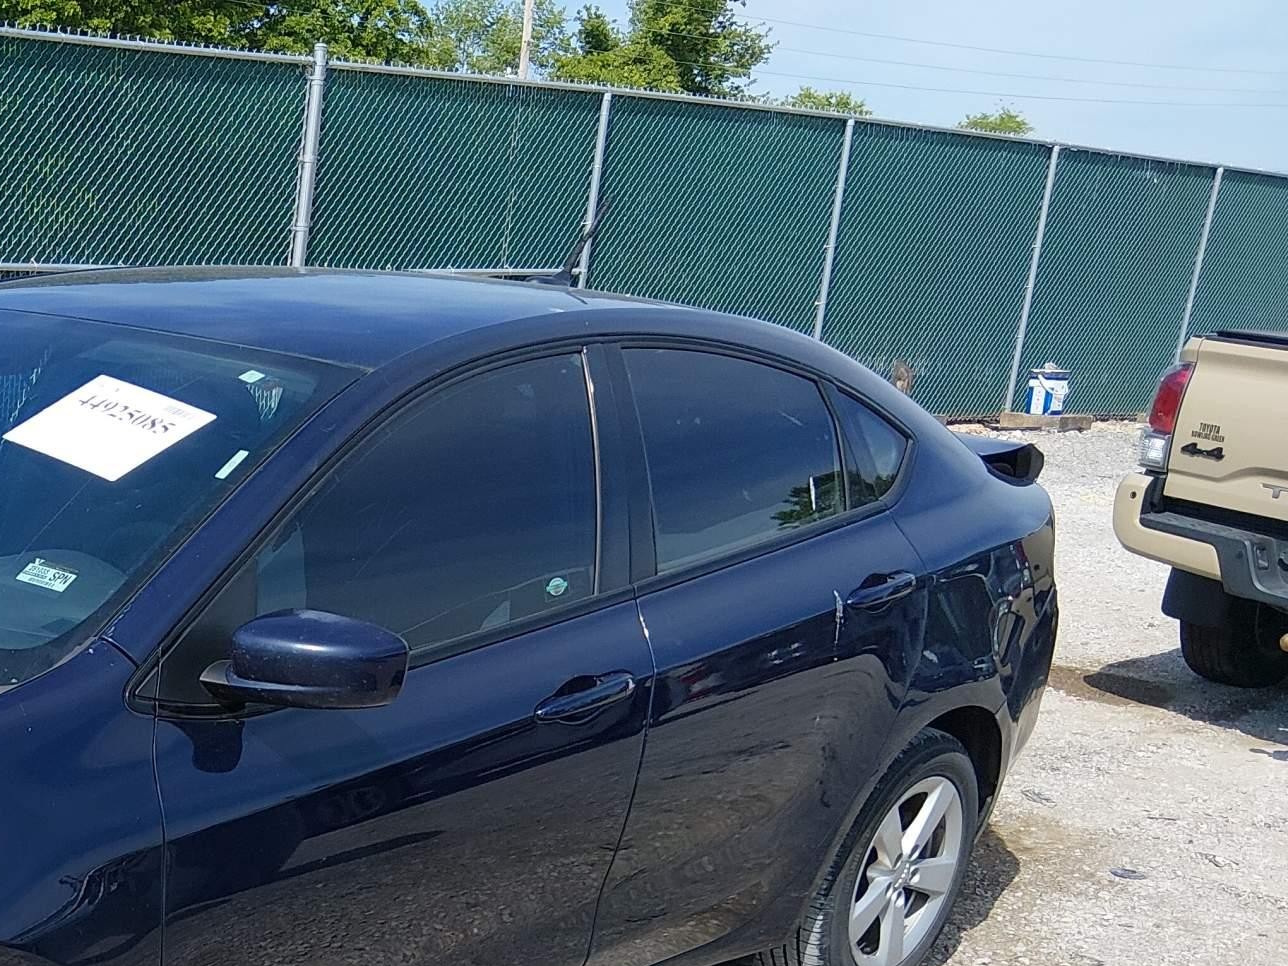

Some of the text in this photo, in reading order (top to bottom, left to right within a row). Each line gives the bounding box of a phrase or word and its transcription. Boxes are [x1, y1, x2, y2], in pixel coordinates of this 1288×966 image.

[79, 395, 176, 434] 44925085
[1199, 422, 1221, 435] TOYOTA
[1211, 434, 1225, 443] GREEN
